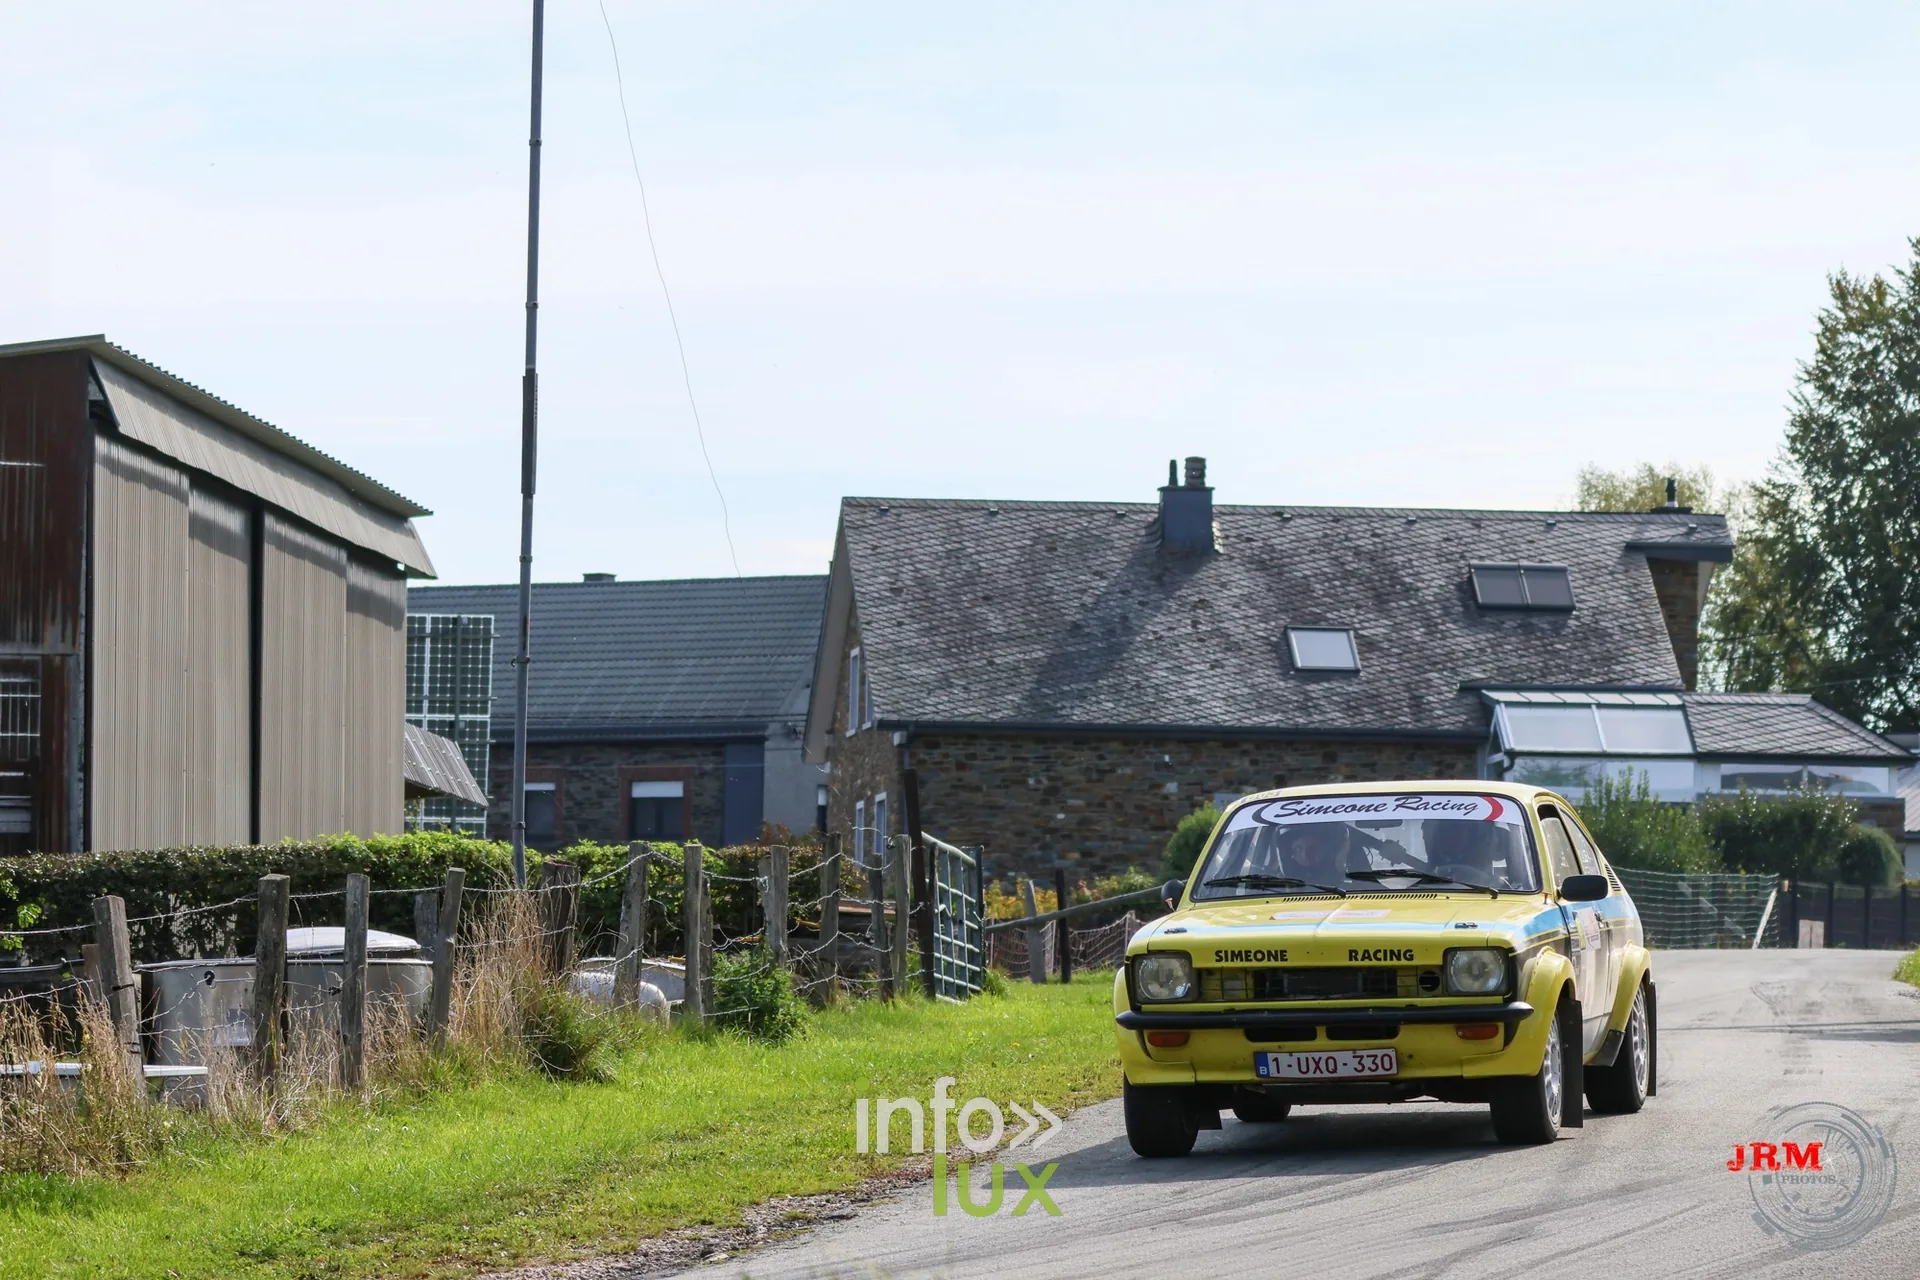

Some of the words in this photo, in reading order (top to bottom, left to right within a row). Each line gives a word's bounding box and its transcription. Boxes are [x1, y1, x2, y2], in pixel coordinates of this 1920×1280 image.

[1274, 801, 1388, 818] Simeone
[1392, 796, 1479, 815] Racing
[1215, 949, 1288, 963] SIMEONE
[1348, 949, 1414, 962] RACING
[1272, 1053, 1393, 1075] 1-UXQ-330
